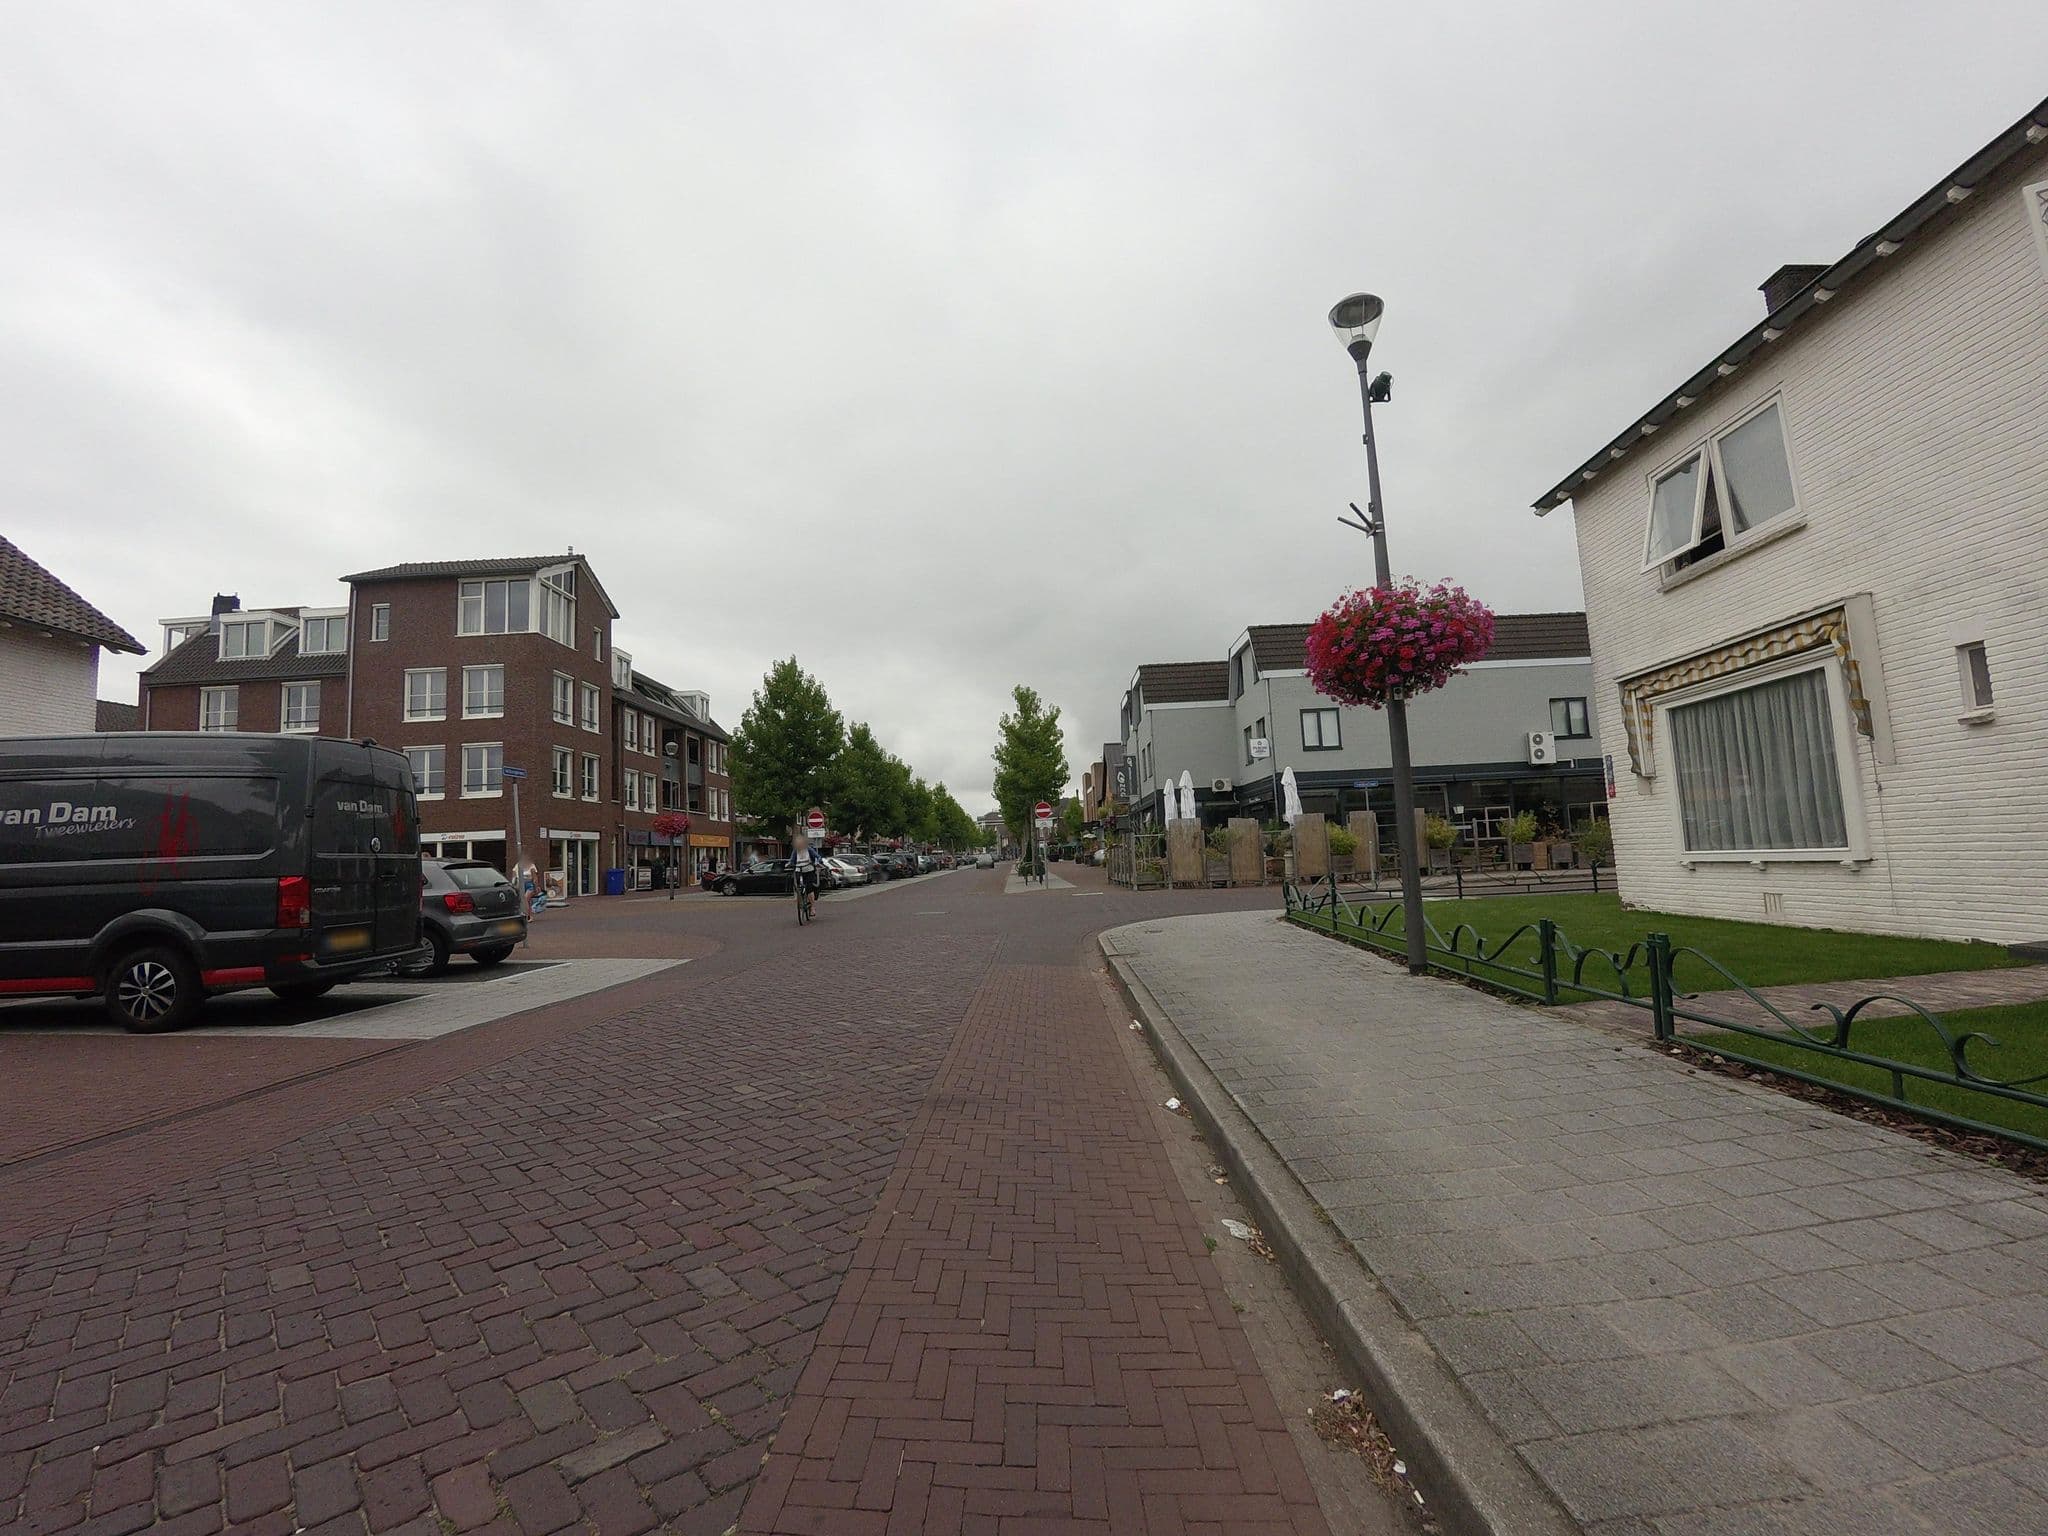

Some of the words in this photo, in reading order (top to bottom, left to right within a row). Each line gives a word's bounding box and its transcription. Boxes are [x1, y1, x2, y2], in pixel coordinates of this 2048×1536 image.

[48, 802, 117, 823] Dam
[336, 801, 358, 812] van
[359, 799, 383, 813] Dam
